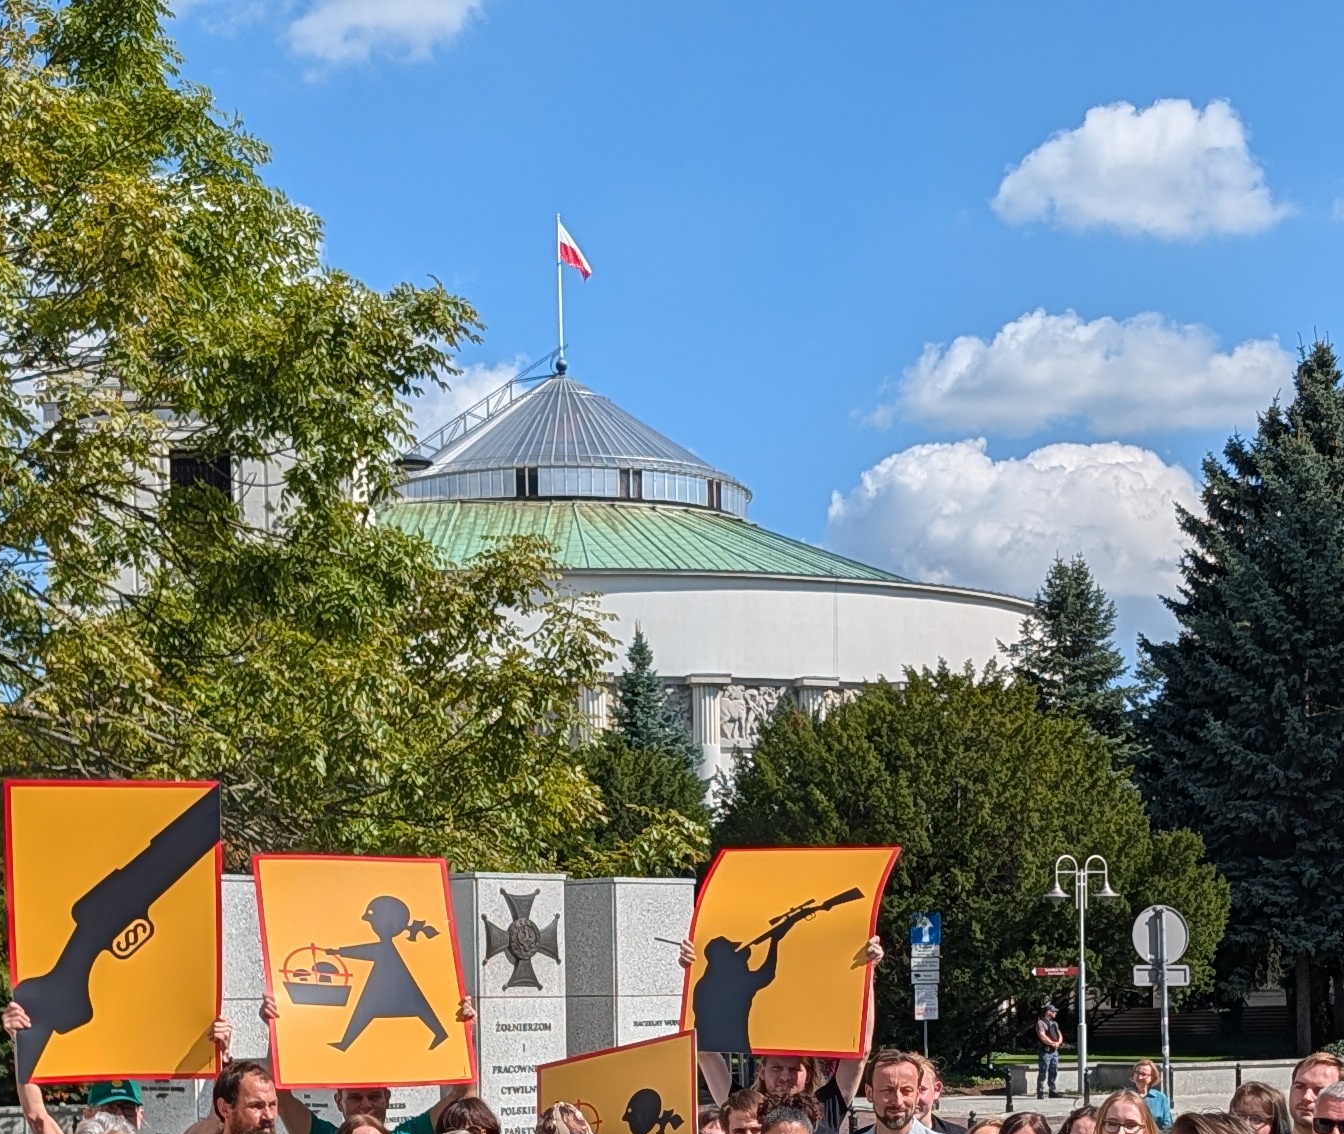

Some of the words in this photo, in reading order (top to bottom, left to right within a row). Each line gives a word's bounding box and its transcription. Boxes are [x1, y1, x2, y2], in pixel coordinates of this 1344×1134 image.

[495, 1022, 552, 1032] ŻOŁNIERZOM
[492, 1065, 537, 1074] PRACOWNI
[501, 1086, 537, 1095] CYWILN
[501, 1106, 536, 1116] POLSKIE
